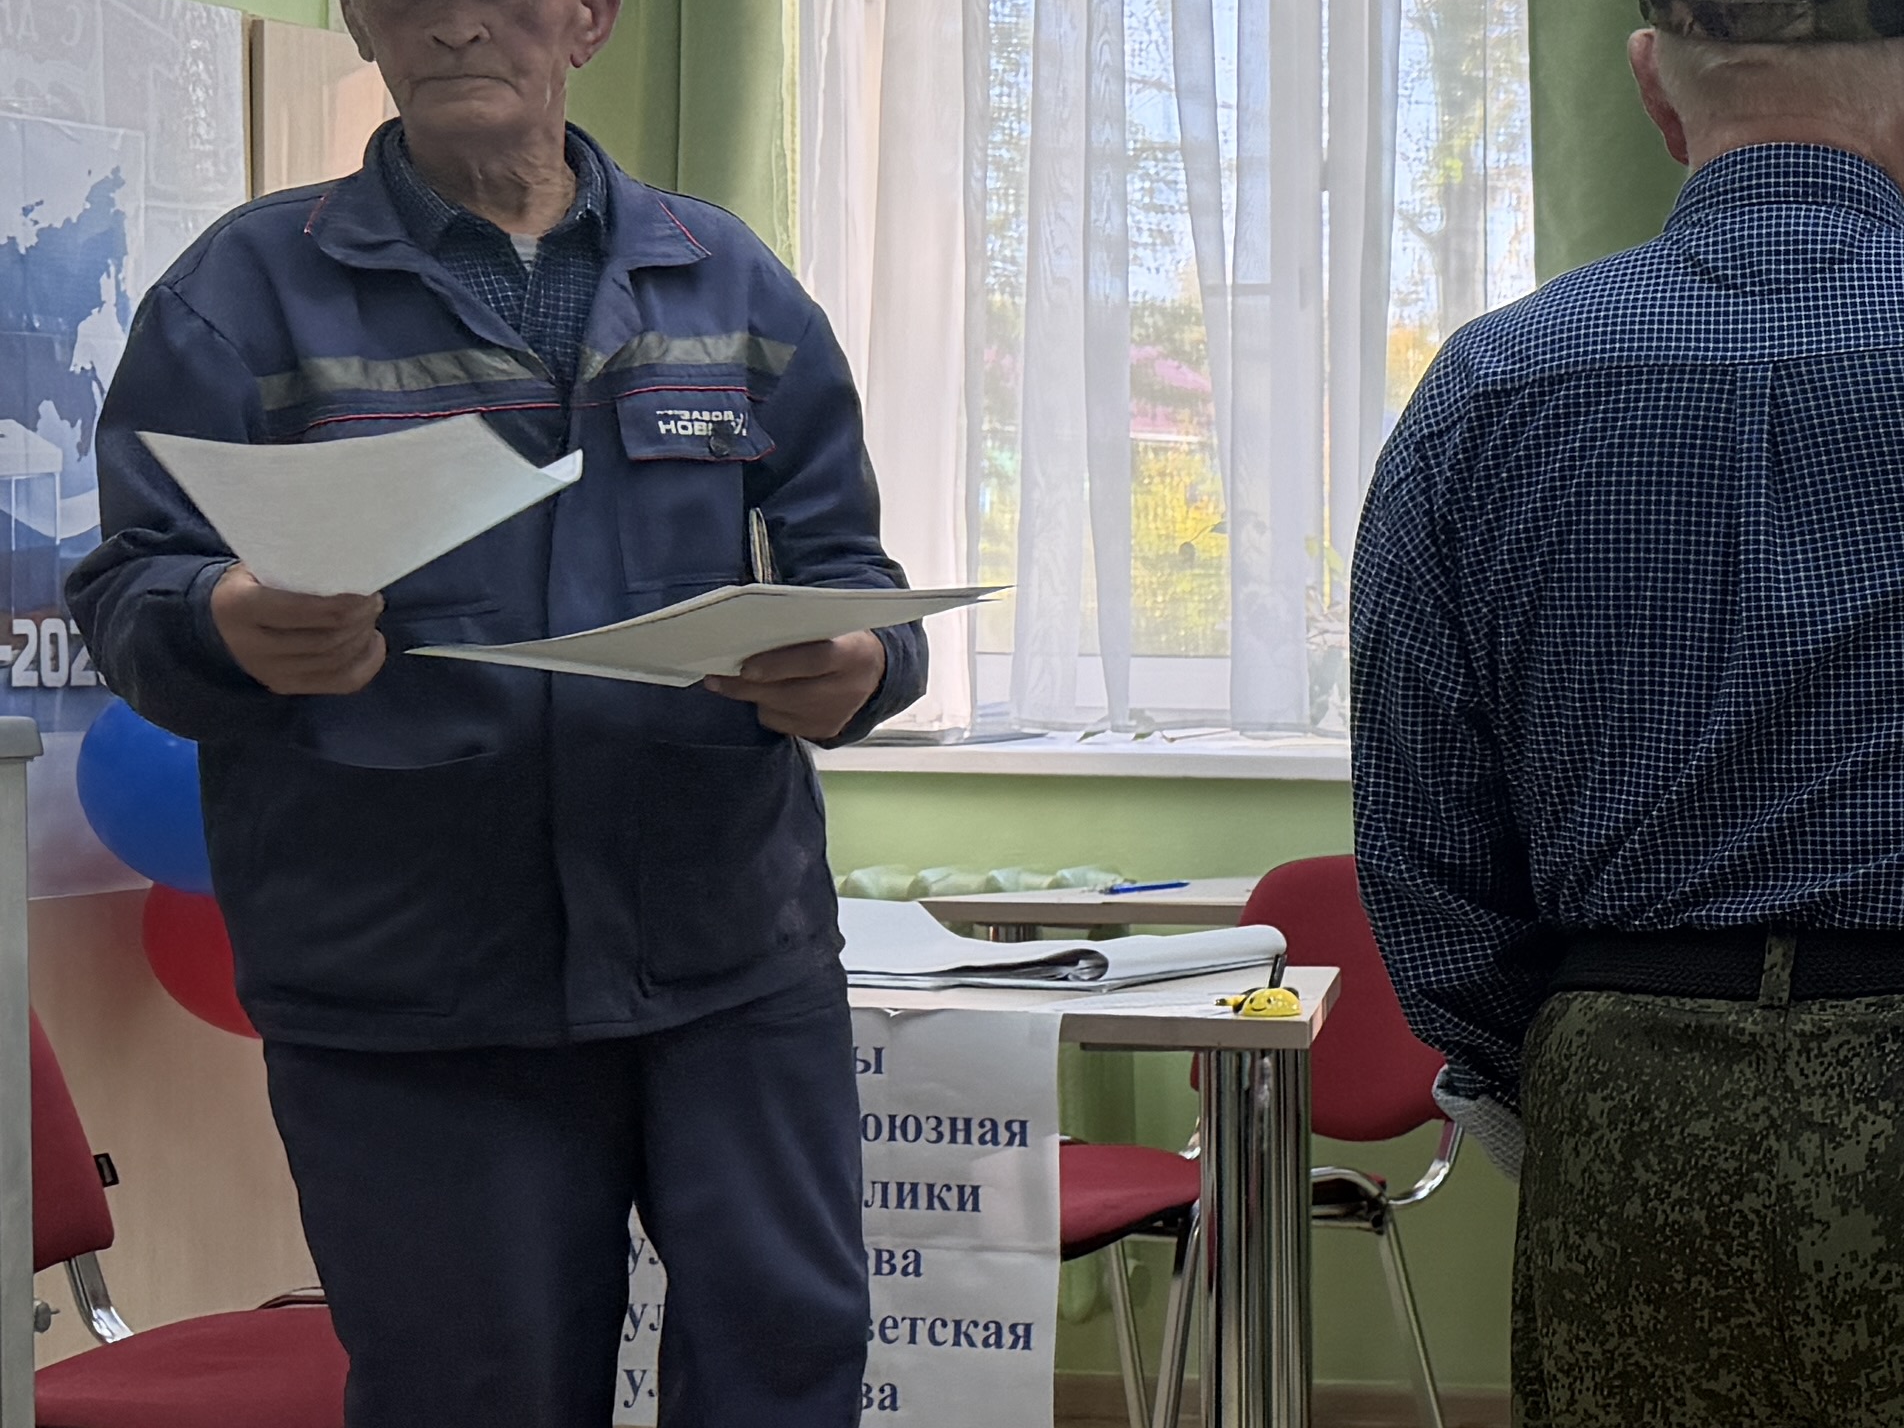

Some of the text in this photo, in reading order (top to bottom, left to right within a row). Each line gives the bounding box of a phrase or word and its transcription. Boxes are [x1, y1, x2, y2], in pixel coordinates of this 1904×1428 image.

[0, 617, 108, 688] -202
[861, 1112, 1030, 1149] оюзная
[863, 1179, 981, 1214] лики
[867, 1316, 1035, 1352] етская
